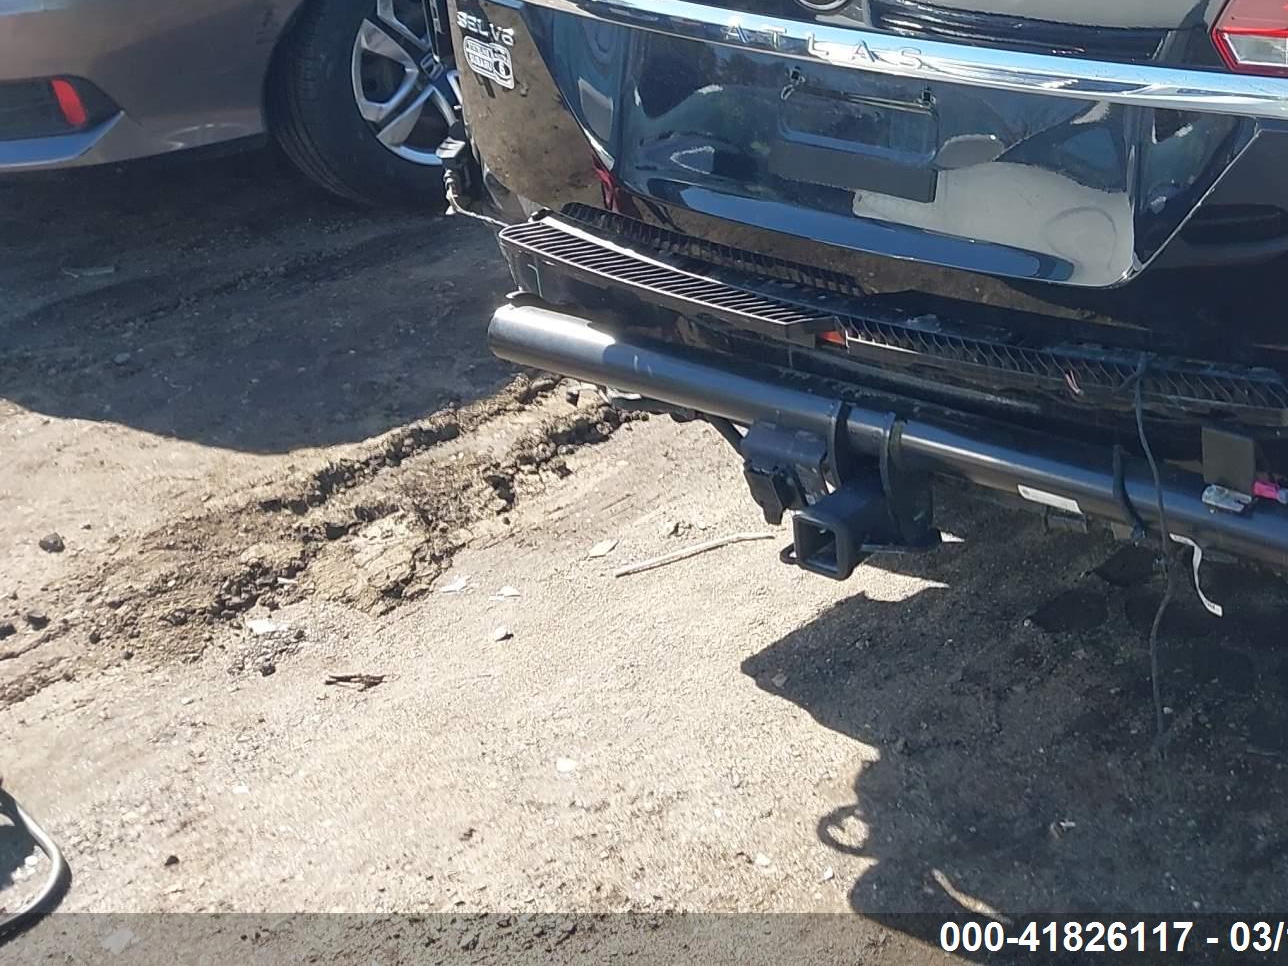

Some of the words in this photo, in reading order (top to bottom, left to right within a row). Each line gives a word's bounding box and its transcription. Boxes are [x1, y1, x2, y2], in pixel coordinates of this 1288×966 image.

[456, 11, 489, 37] SEL
[489, 23, 515, 47] V6
[720, 15, 924, 71] ATLAS
